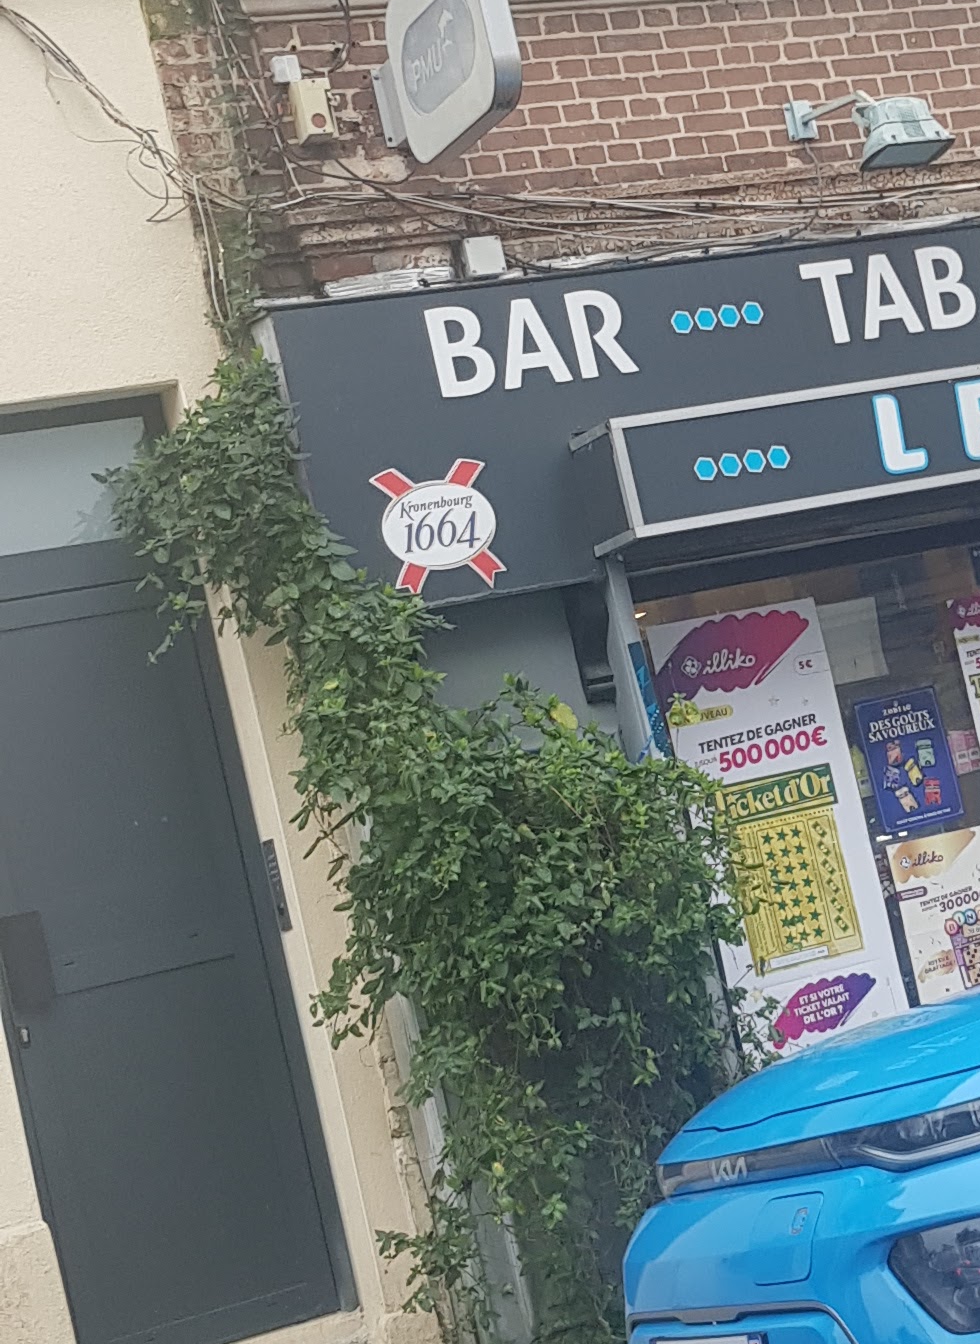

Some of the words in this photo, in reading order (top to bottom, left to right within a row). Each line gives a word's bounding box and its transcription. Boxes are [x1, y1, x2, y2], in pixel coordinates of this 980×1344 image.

[412, 38, 443, 93] PMU
[423, 289, 640, 398] BAR
[400, 495, 473, 521] Kronenbourg
[404, 508, 482, 554] 1664
[702, 648, 756, 675] illiko
[698, 732, 745, 754] TENTEZ
[746, 727, 762, 742] DE
[764, 713, 817, 736] GAGNER
[868, 718, 936, 744] SAVOUREUX
[869, 720, 891, 733] DES
[719, 743, 763, 772] 500
[764, 726, 828, 759] 000€
[783, 771, 831, 805] d'Or
[912, 851, 944, 867] illiko
[794, 1000, 821, 1016] TICKET
[821, 992, 850, 1007] VALAIT
[799, 996, 809, 1005] ET
[810, 993, 818, 1002] SI
[818, 984, 845, 1000] VOTRE
[803, 1014, 816, 1024] DE
[816, 1008, 838, 1021] L'OR
